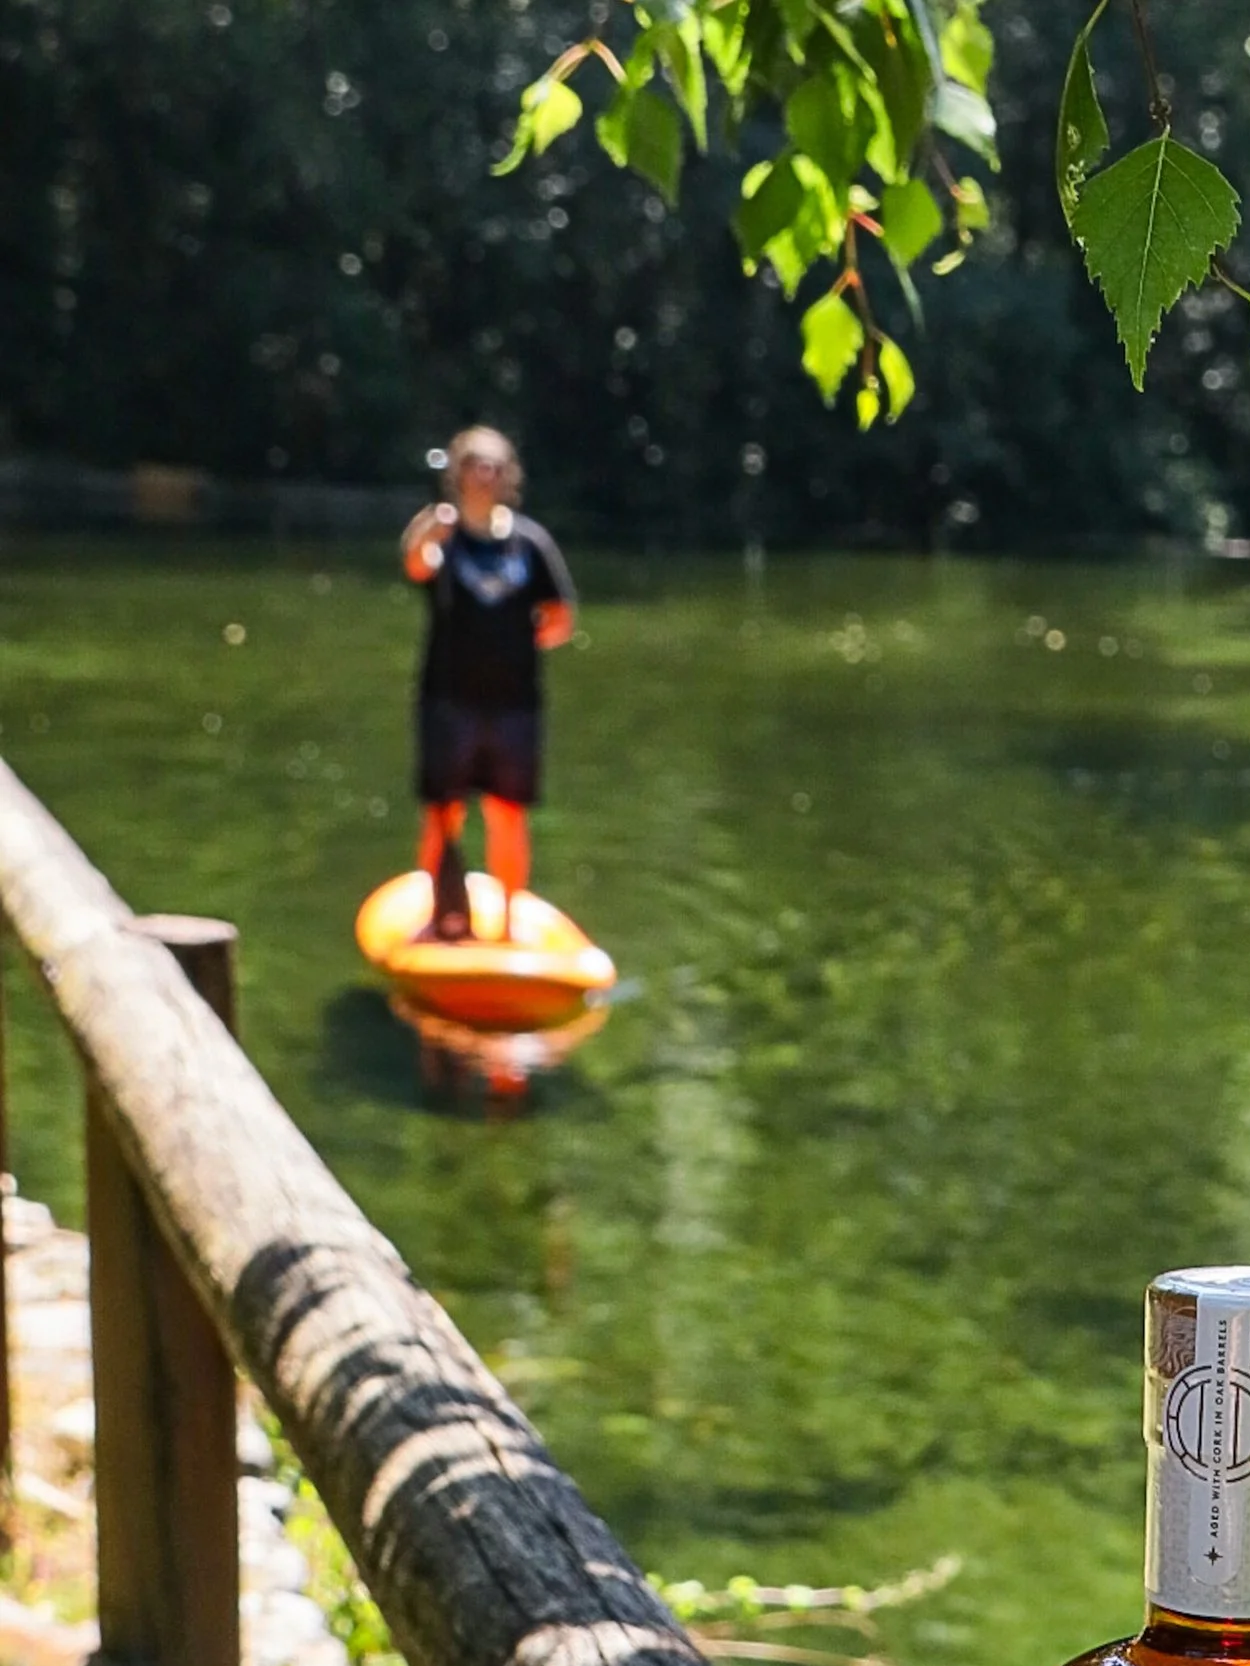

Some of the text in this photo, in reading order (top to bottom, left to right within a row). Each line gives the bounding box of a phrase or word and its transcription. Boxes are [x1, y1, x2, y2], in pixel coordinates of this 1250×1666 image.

[1210, 1320, 1227, 1538] AGED WITH CORK IN OAK BARRELS
